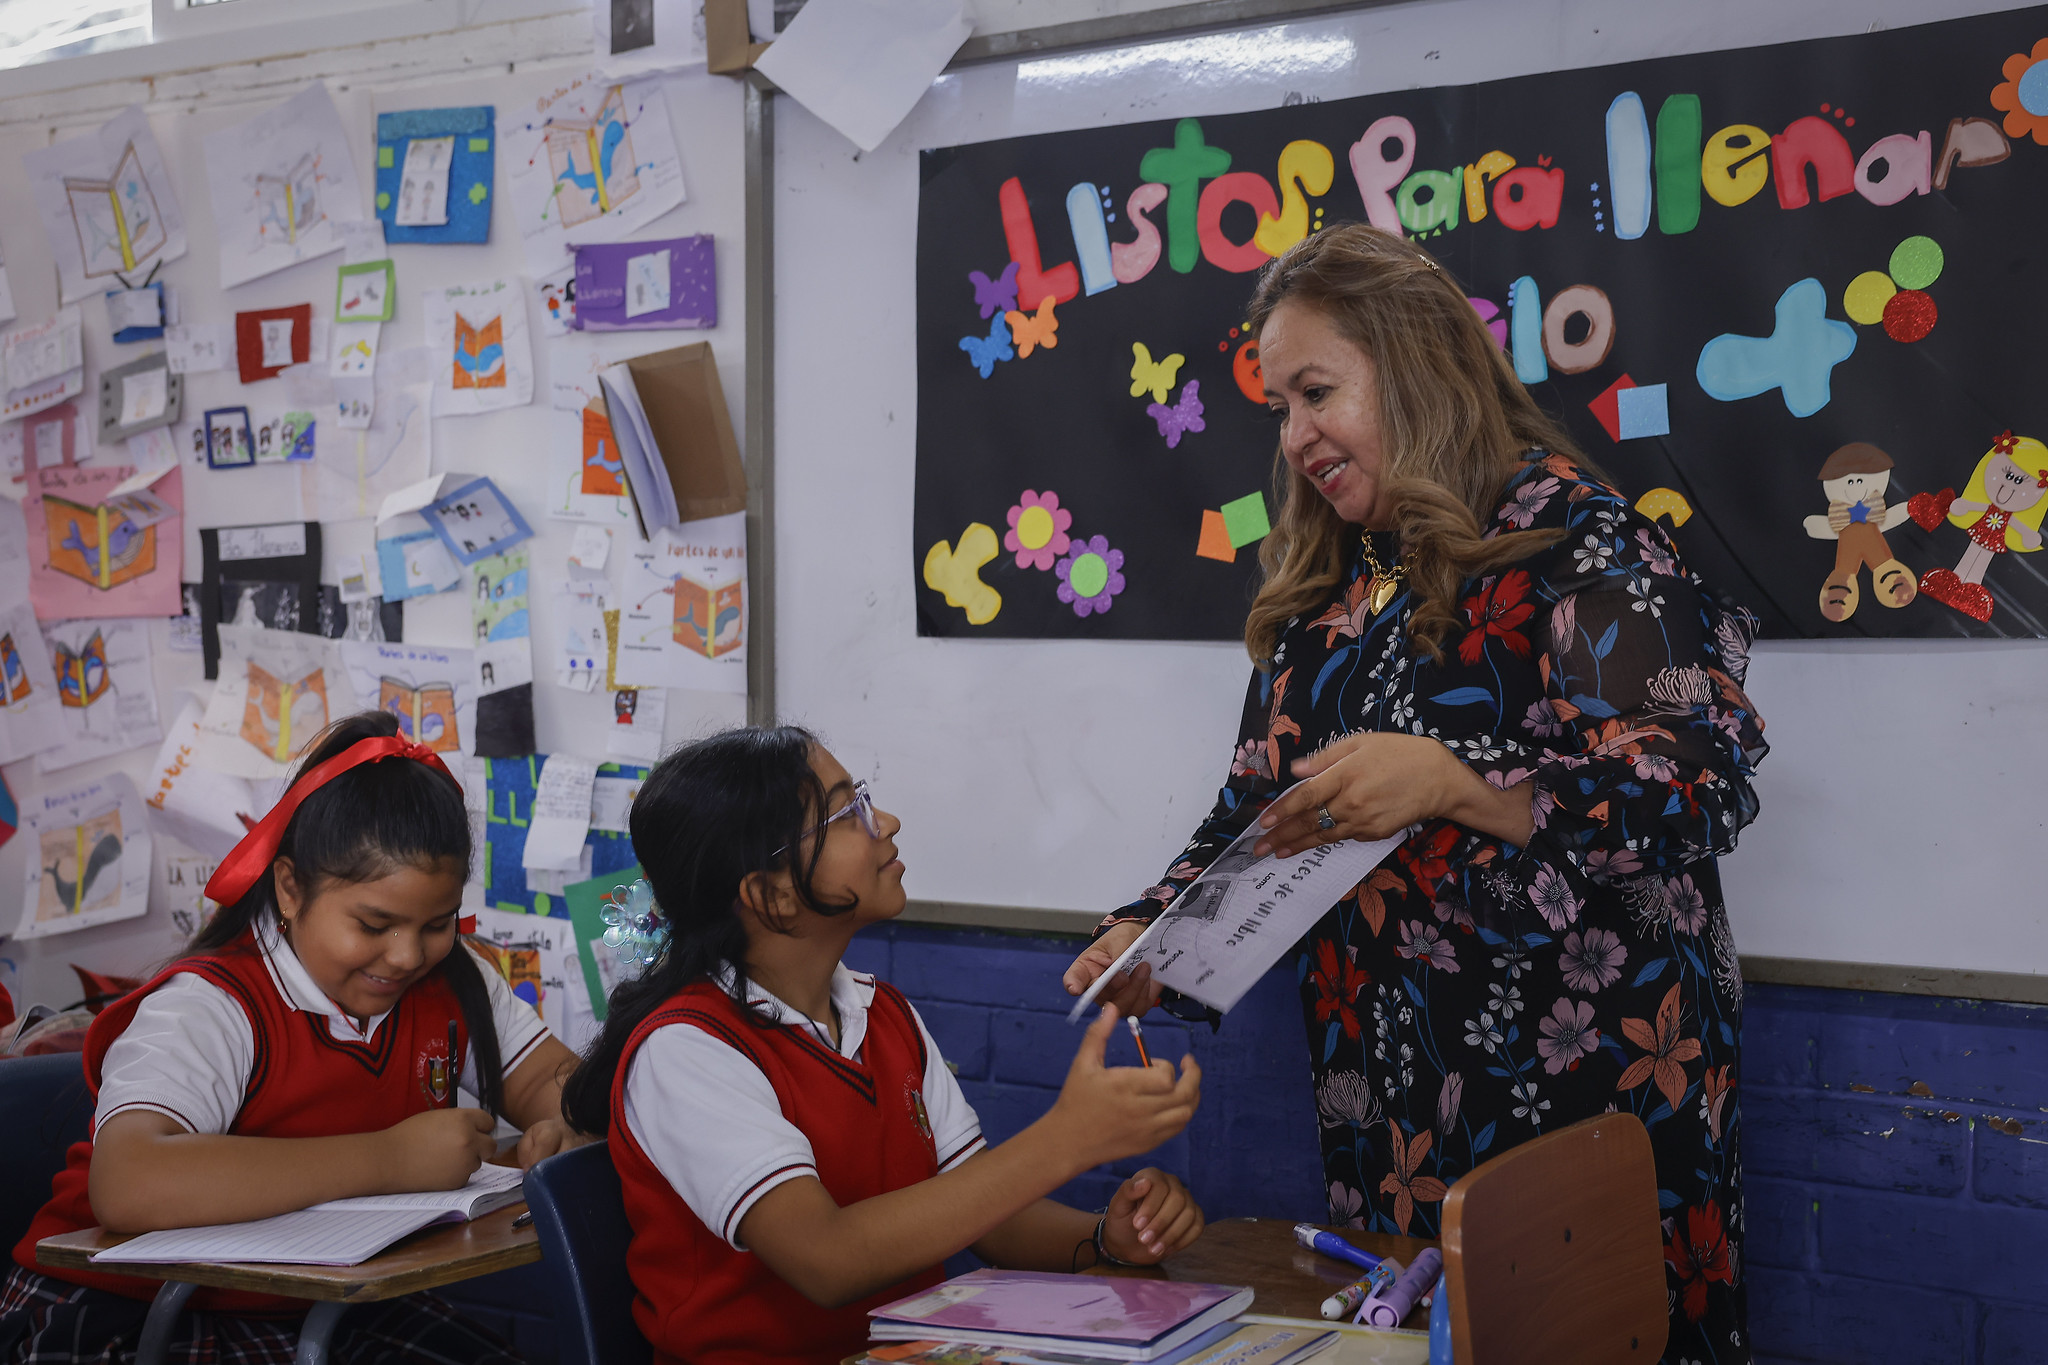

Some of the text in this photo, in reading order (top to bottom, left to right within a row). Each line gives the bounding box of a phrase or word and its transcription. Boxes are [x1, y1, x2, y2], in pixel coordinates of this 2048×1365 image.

[1255, 872, 1276, 890] Lomo
[1273, 882, 1295, 900] de
[1253, 900, 1277, 919] un
